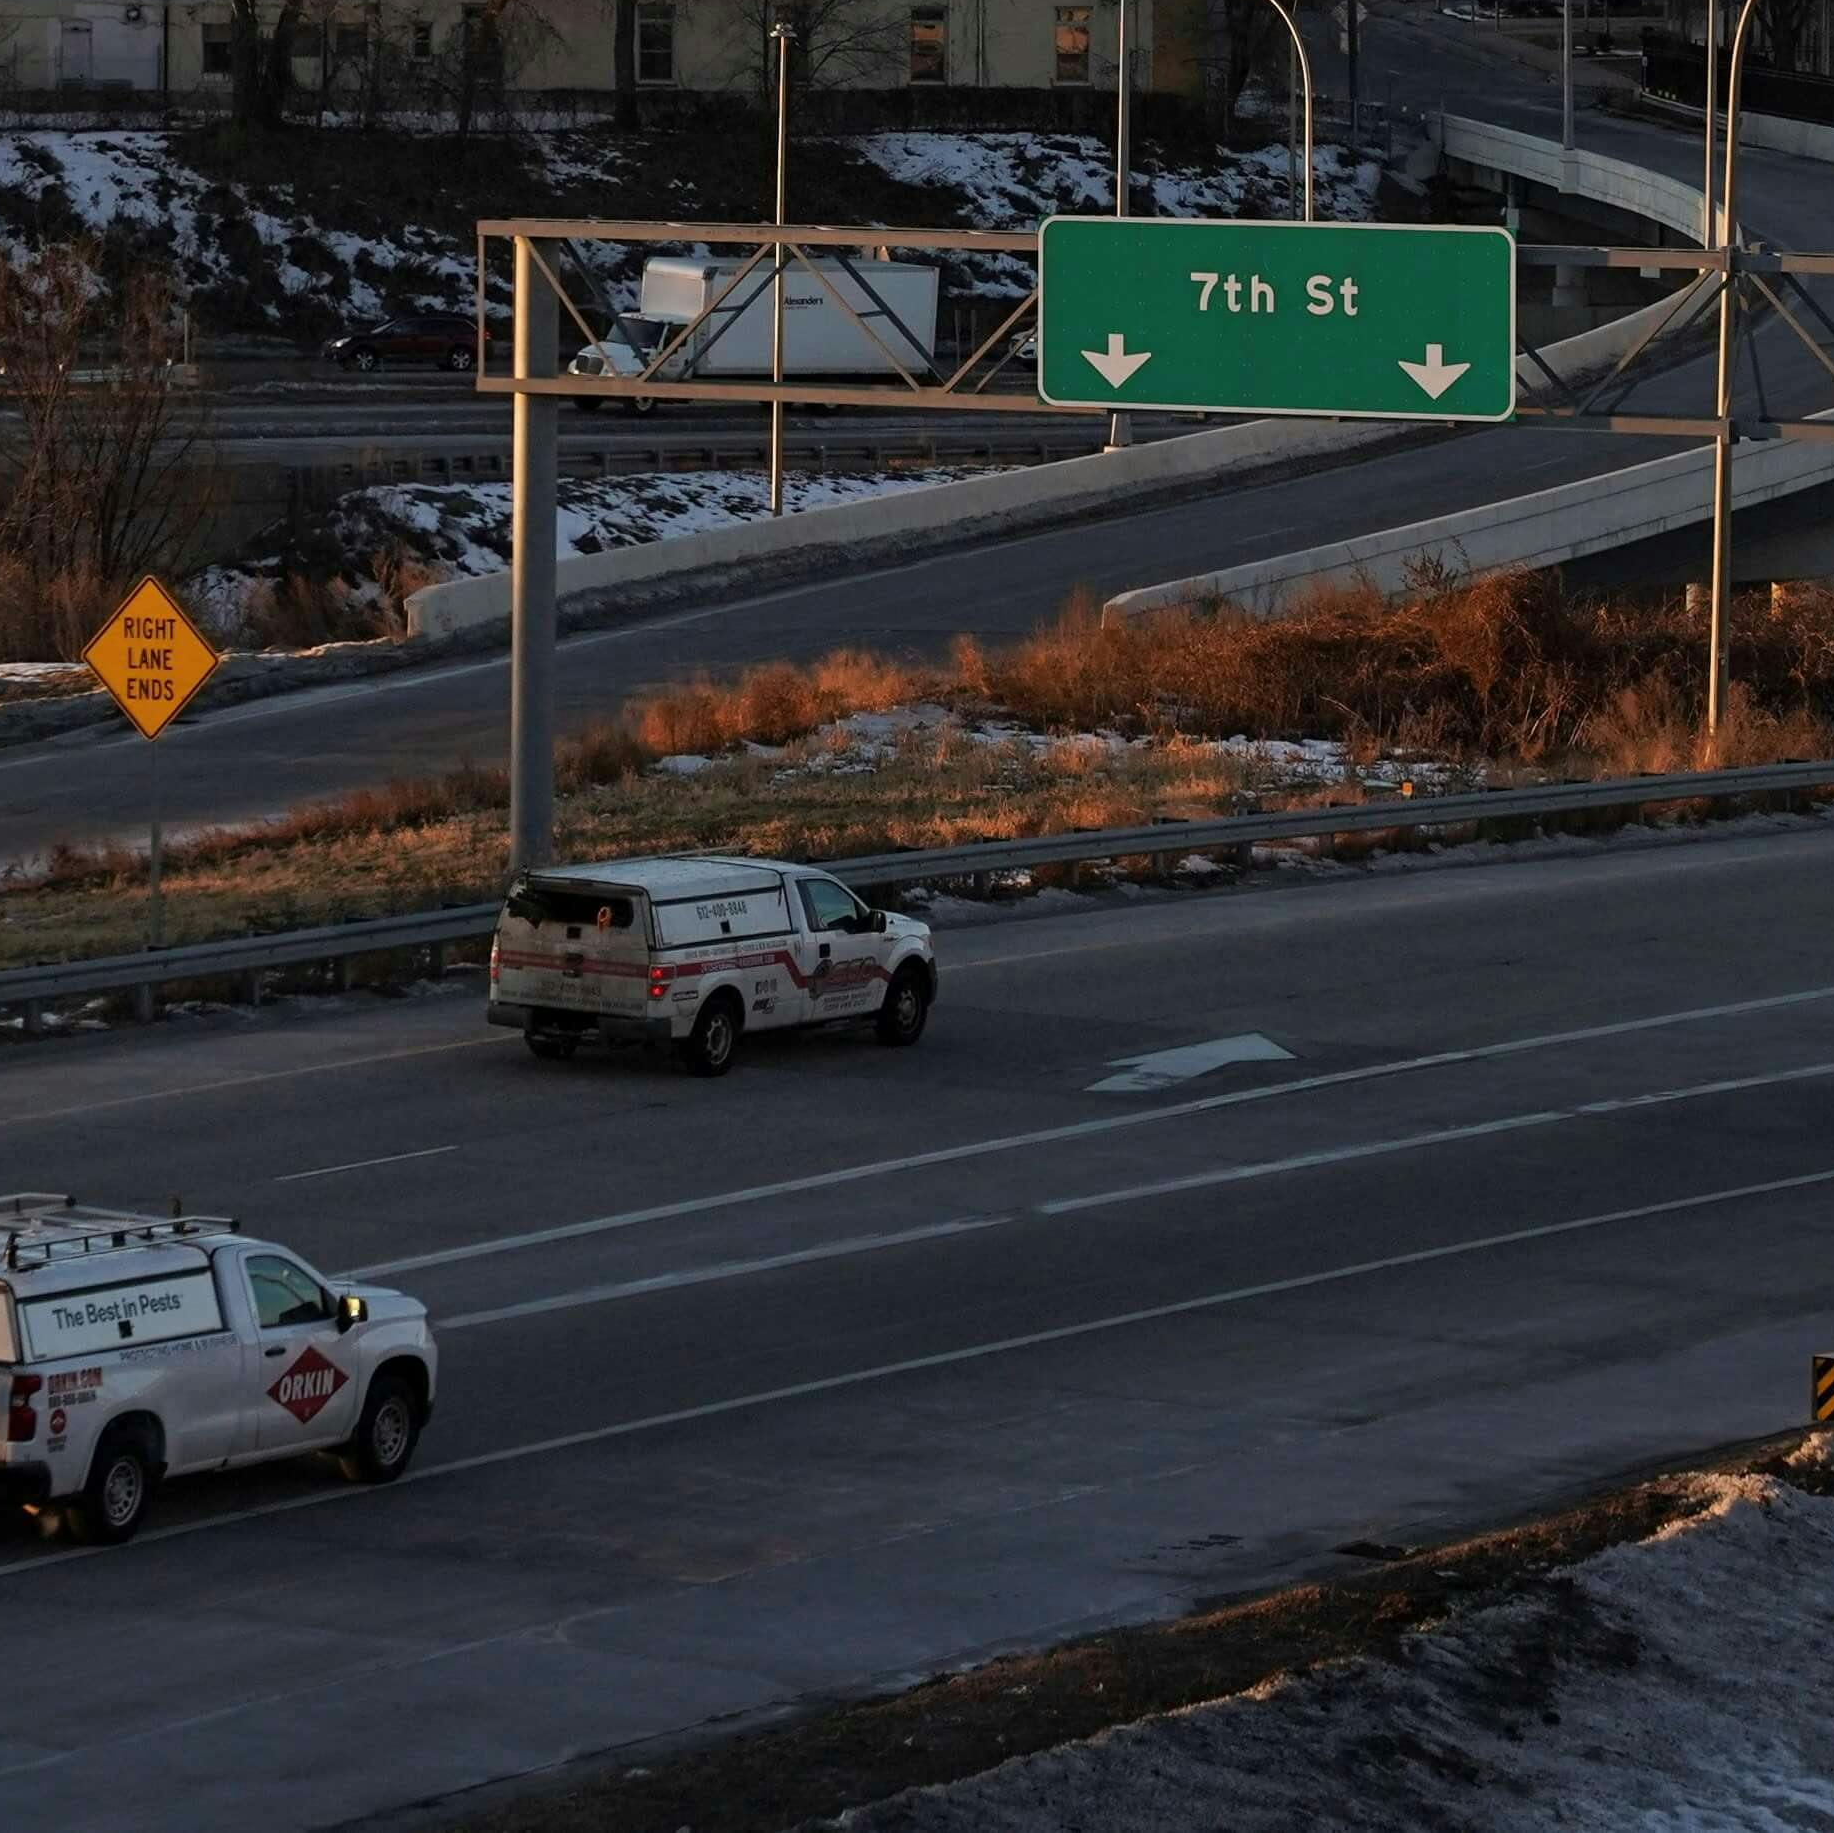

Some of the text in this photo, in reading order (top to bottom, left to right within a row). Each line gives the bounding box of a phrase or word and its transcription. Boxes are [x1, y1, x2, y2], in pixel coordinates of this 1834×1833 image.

[783, 295, 824, 305] Alexanders
[1190, 272, 1359, 316] 7th St
[123, 617, 176, 639] RIGHT
[127, 648, 174, 670] LANE
[126, 678, 175, 700] ENDS
[51, 1293, 181, 1330] The Best in Pests
[279, 1368, 336, 1404] ORKIN
